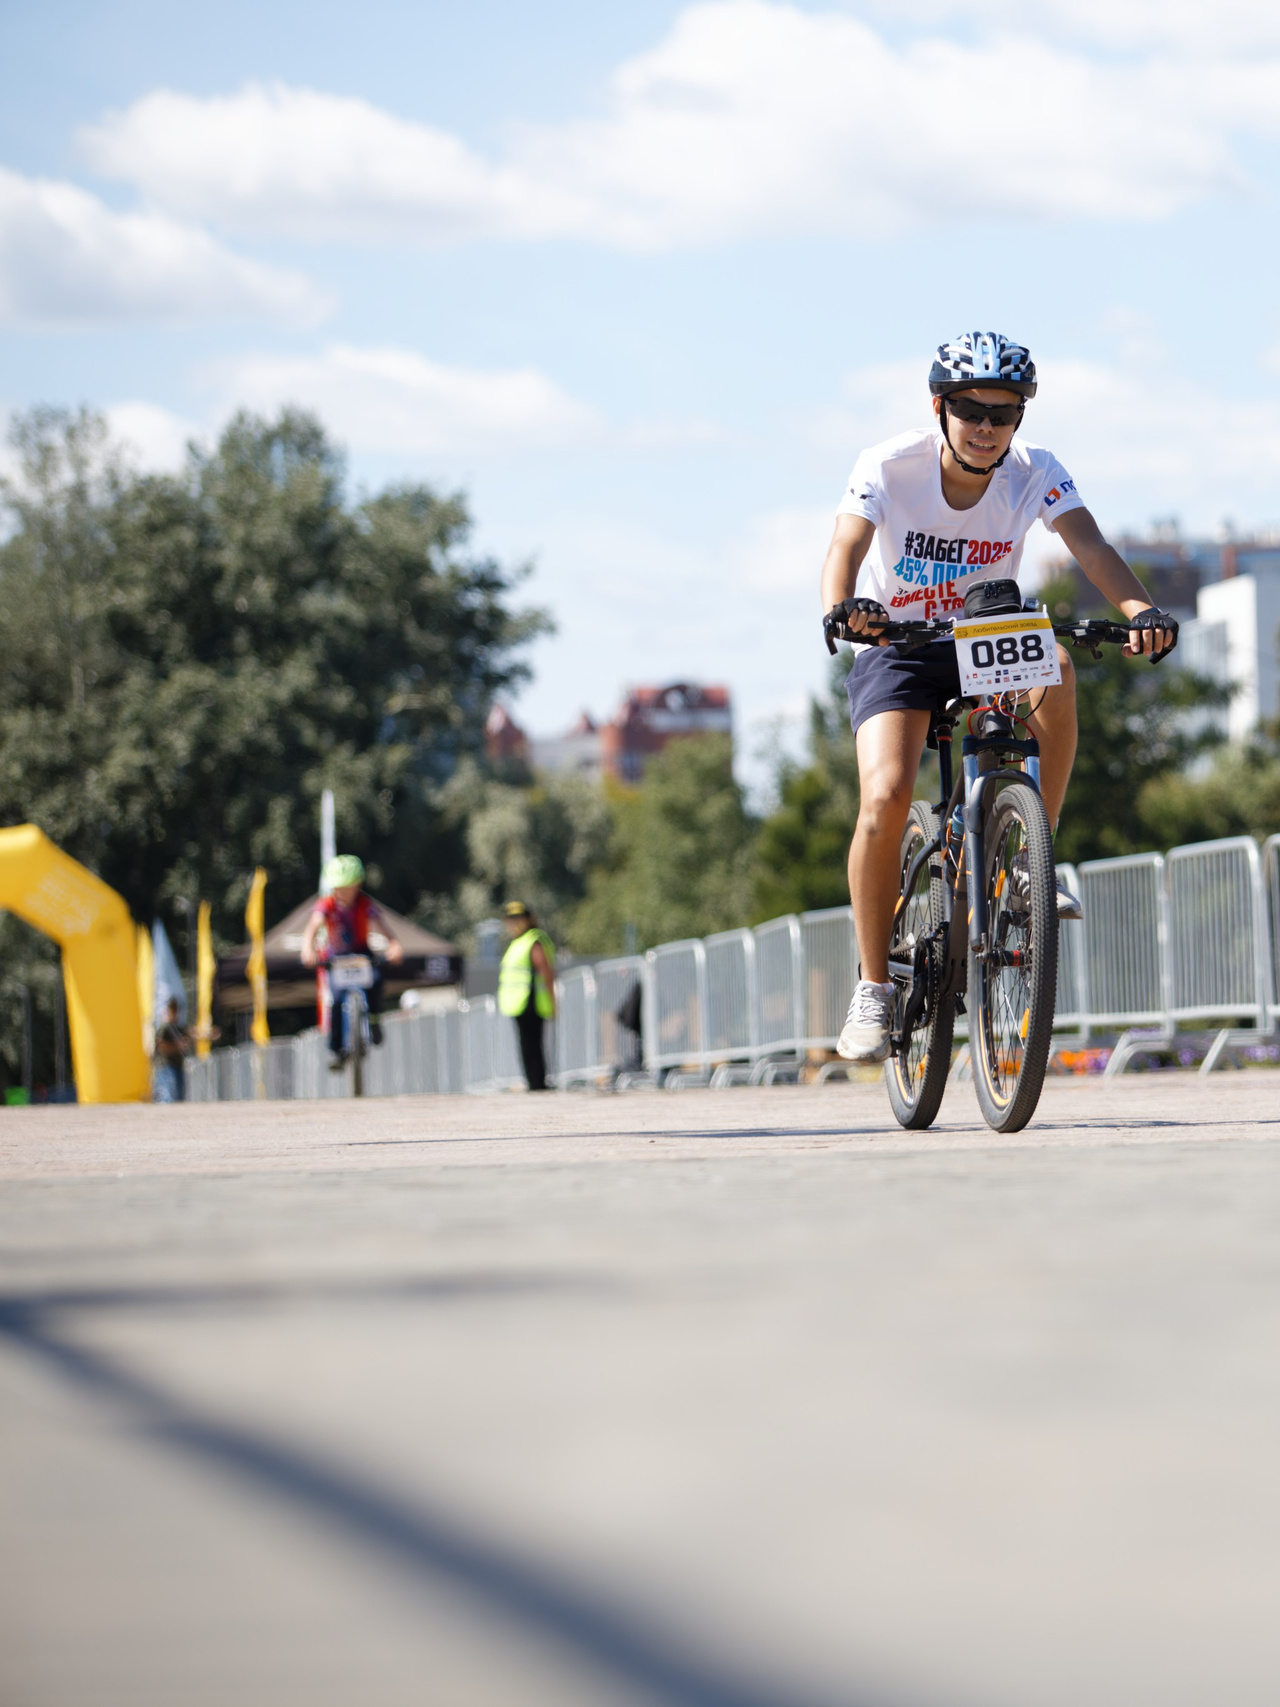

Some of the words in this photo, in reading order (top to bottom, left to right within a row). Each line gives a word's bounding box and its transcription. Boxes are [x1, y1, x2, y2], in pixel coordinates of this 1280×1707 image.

[893, 556, 929, 587] 45%
[890, 580, 957, 608] ВМЕСТЕ
[973, 623, 1018, 634] Любительский
[971, 634, 1044, 668] 088
